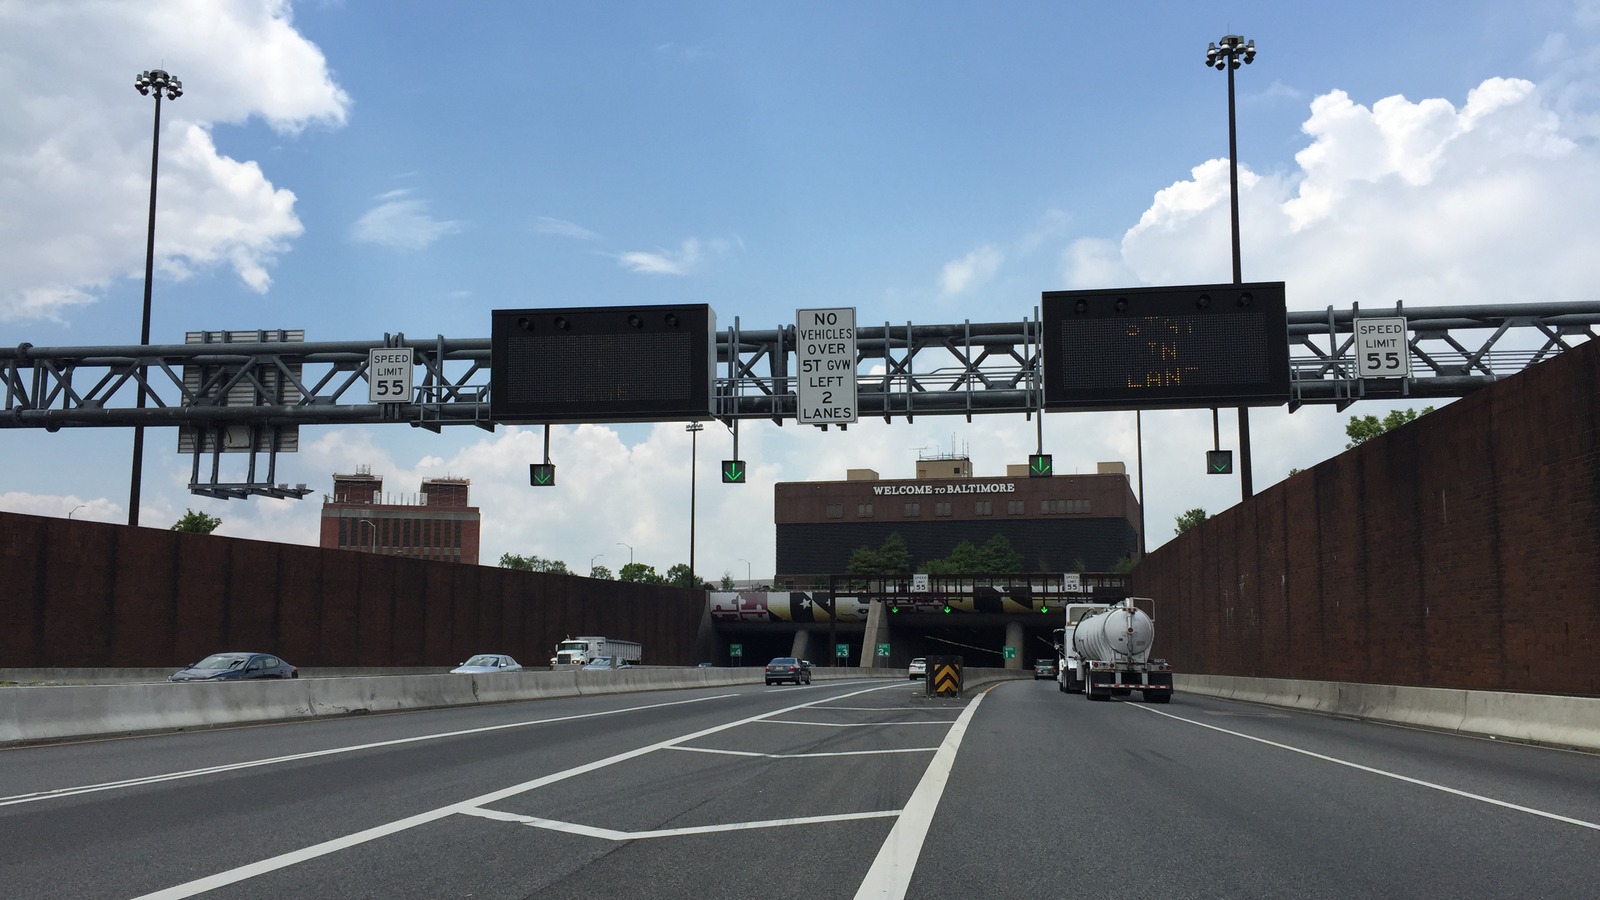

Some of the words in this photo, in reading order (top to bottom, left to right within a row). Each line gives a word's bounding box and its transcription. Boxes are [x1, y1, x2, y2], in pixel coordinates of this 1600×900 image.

[814, 312, 837, 326] NO
[800, 328, 852, 340] VEHICLES
[1360, 324, 1402, 334] SPEED
[808, 343, 846, 355] OVER
[1366, 338, 1397, 348] LIMIT
[374, 354, 408, 364] SPEED
[1367, 352, 1400, 370] 55
[377, 368, 404, 376] LIMIT
[802, 360, 822, 372] 5T
[827, 360, 850, 370] GVW
[810, 376, 844, 388] LEFT
[1127, 366, 1200, 388] LAN
[376, 380, 404, 396] 55
[822, 391, 832, 404] 2
[803, 407, 852, 419] LANES
[873, 485, 932, 495] WELCOME
[946, 483, 1015, 494] BALTIMORE
